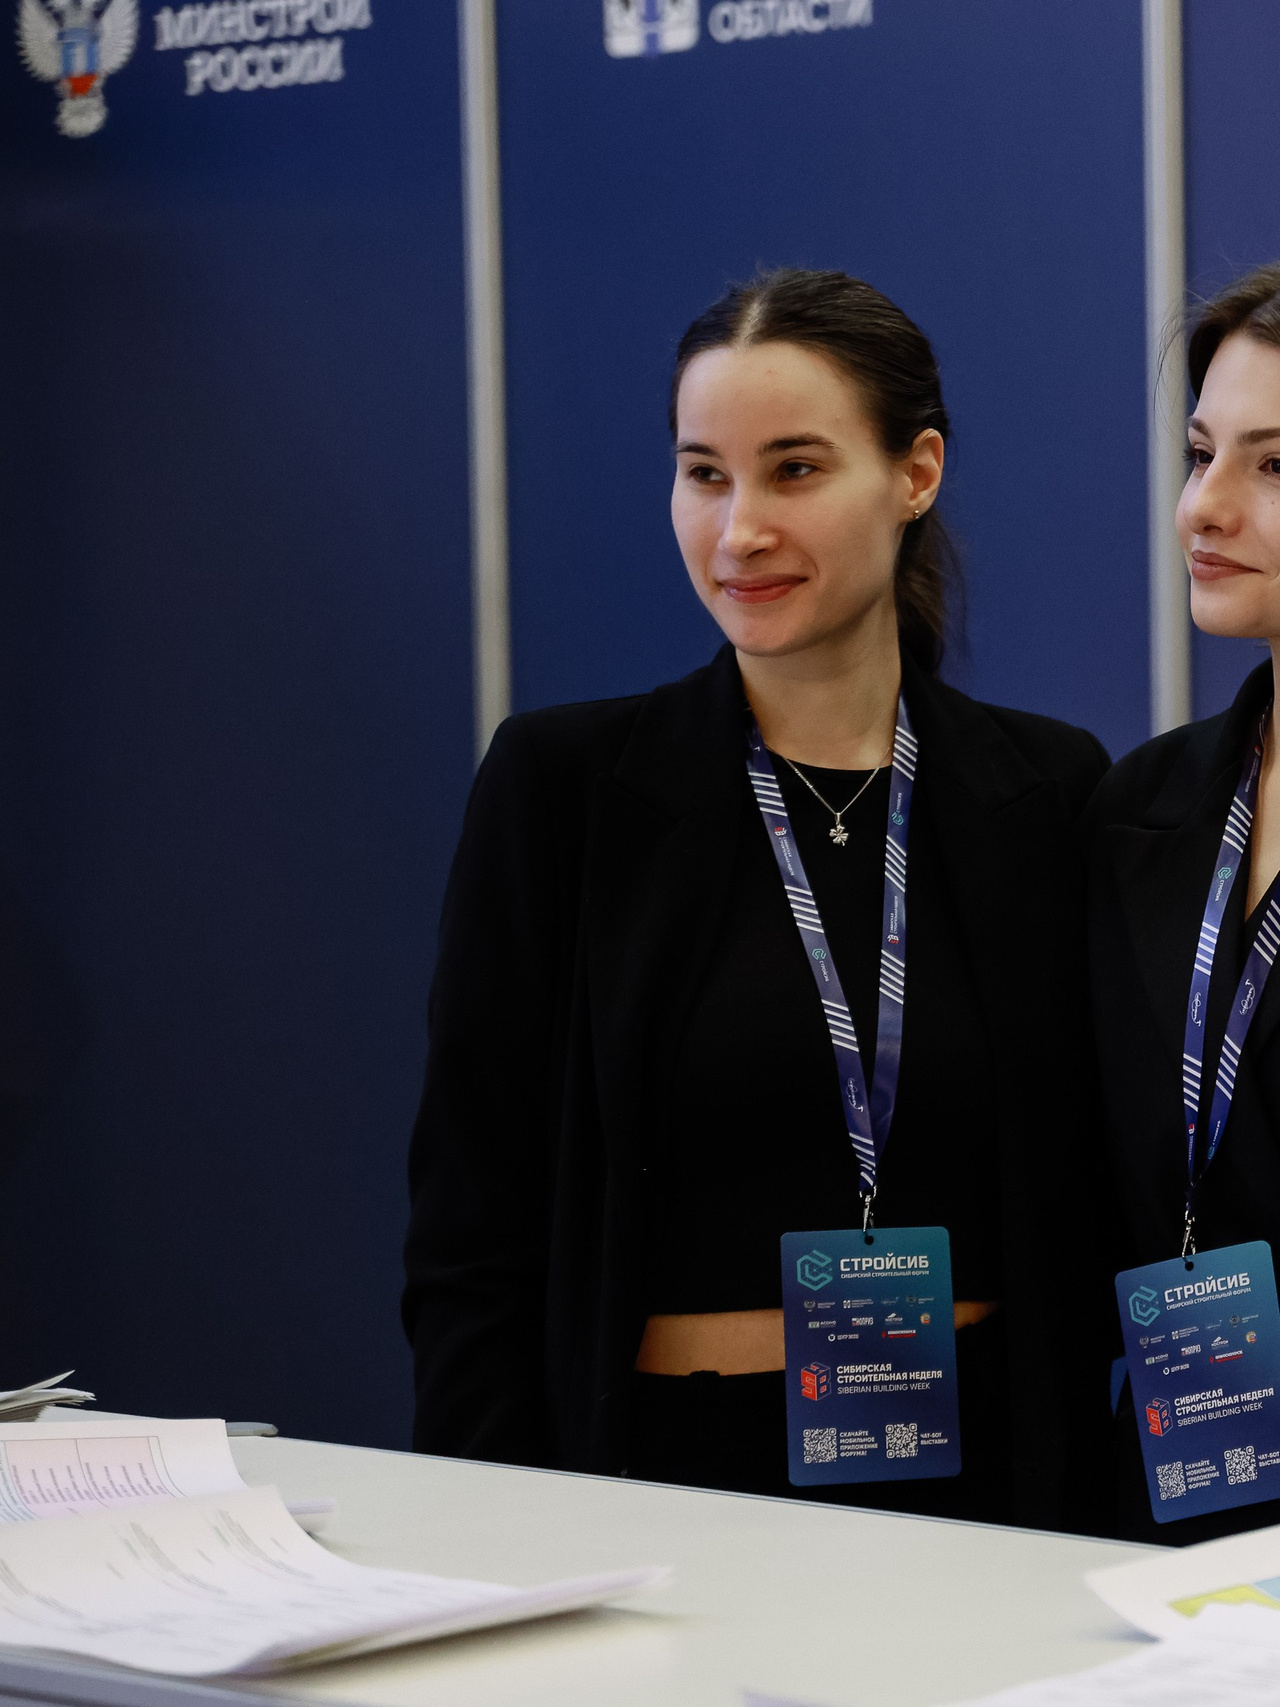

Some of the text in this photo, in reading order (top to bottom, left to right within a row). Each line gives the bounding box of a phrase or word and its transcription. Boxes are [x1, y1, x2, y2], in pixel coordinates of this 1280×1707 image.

[708, 0, 873, 43] ОБЛАСТИ
[184, 36, 345, 95] РОССИИ
[840, 1252, 930, 1272] СТРОЙСИБ
[1164, 1272, 1250, 1303] СТРОЙСИБ
[1166, 1287, 1252, 1311] СИБИРСКИЙ СТРОИТЕЛЬНЫЙ ФОРУМ
[836, 1363, 892, 1375] СИБИРСКАЯ
[837, 1370, 942, 1384] СТРОИТЕЛЬНАЯ НЕДЕЛЯ
[837, 1382, 930, 1395] SIBERIAN BUILDING WEEK
[1174, 1388, 1223, 1407] СИБИРСКАЯ
[1175, 1387, 1274, 1416] СТРОИТЕЛЬНАЯ НЕДЕЛЯ
[1177, 1402, 1263, 1427] SIBERIAN BUILDING WEEK
[839, 1430, 869, 1438] СКАЧАЙТЕ
[840, 1436, 875, 1444] МОБИЛЬНОЕ
[840, 1443, 878, 1451] ПРИЛОЖЕНИЕ
[1258, 1451, 1280, 1461] ЧАТ-БОТ
[1185, 1460, 1210, 1470] СКАЧАЙТЕ
[1186, 1466, 1216, 1476] МОБИЛЬНОЕ
[1187, 1472, 1220, 1483] ПРИЛОЖЕНИЕ
[1188, 1480, 1212, 1490] ФОРУМА!
